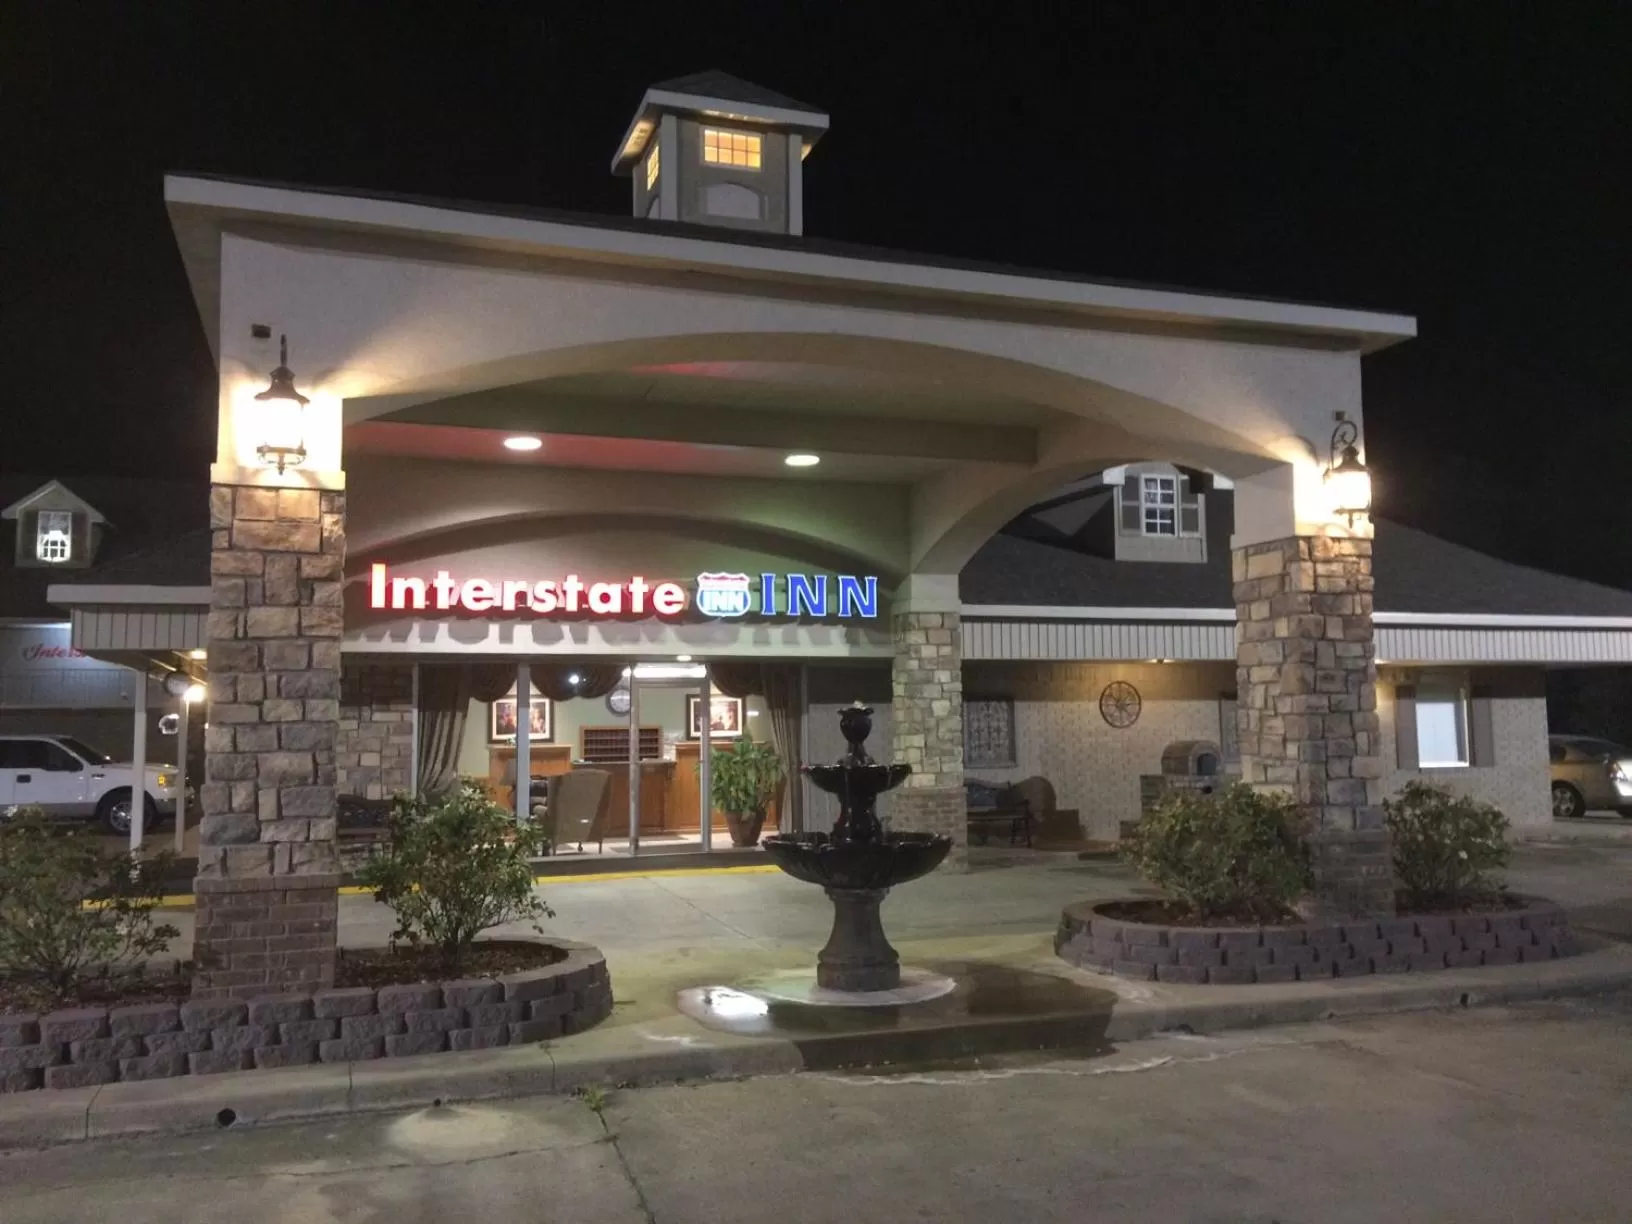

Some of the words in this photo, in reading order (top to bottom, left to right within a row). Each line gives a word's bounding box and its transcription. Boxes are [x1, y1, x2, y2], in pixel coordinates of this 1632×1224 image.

[371, 563, 686, 614] Interstate
[760, 572, 877, 618] INN
[703, 589, 745, 613] INN
